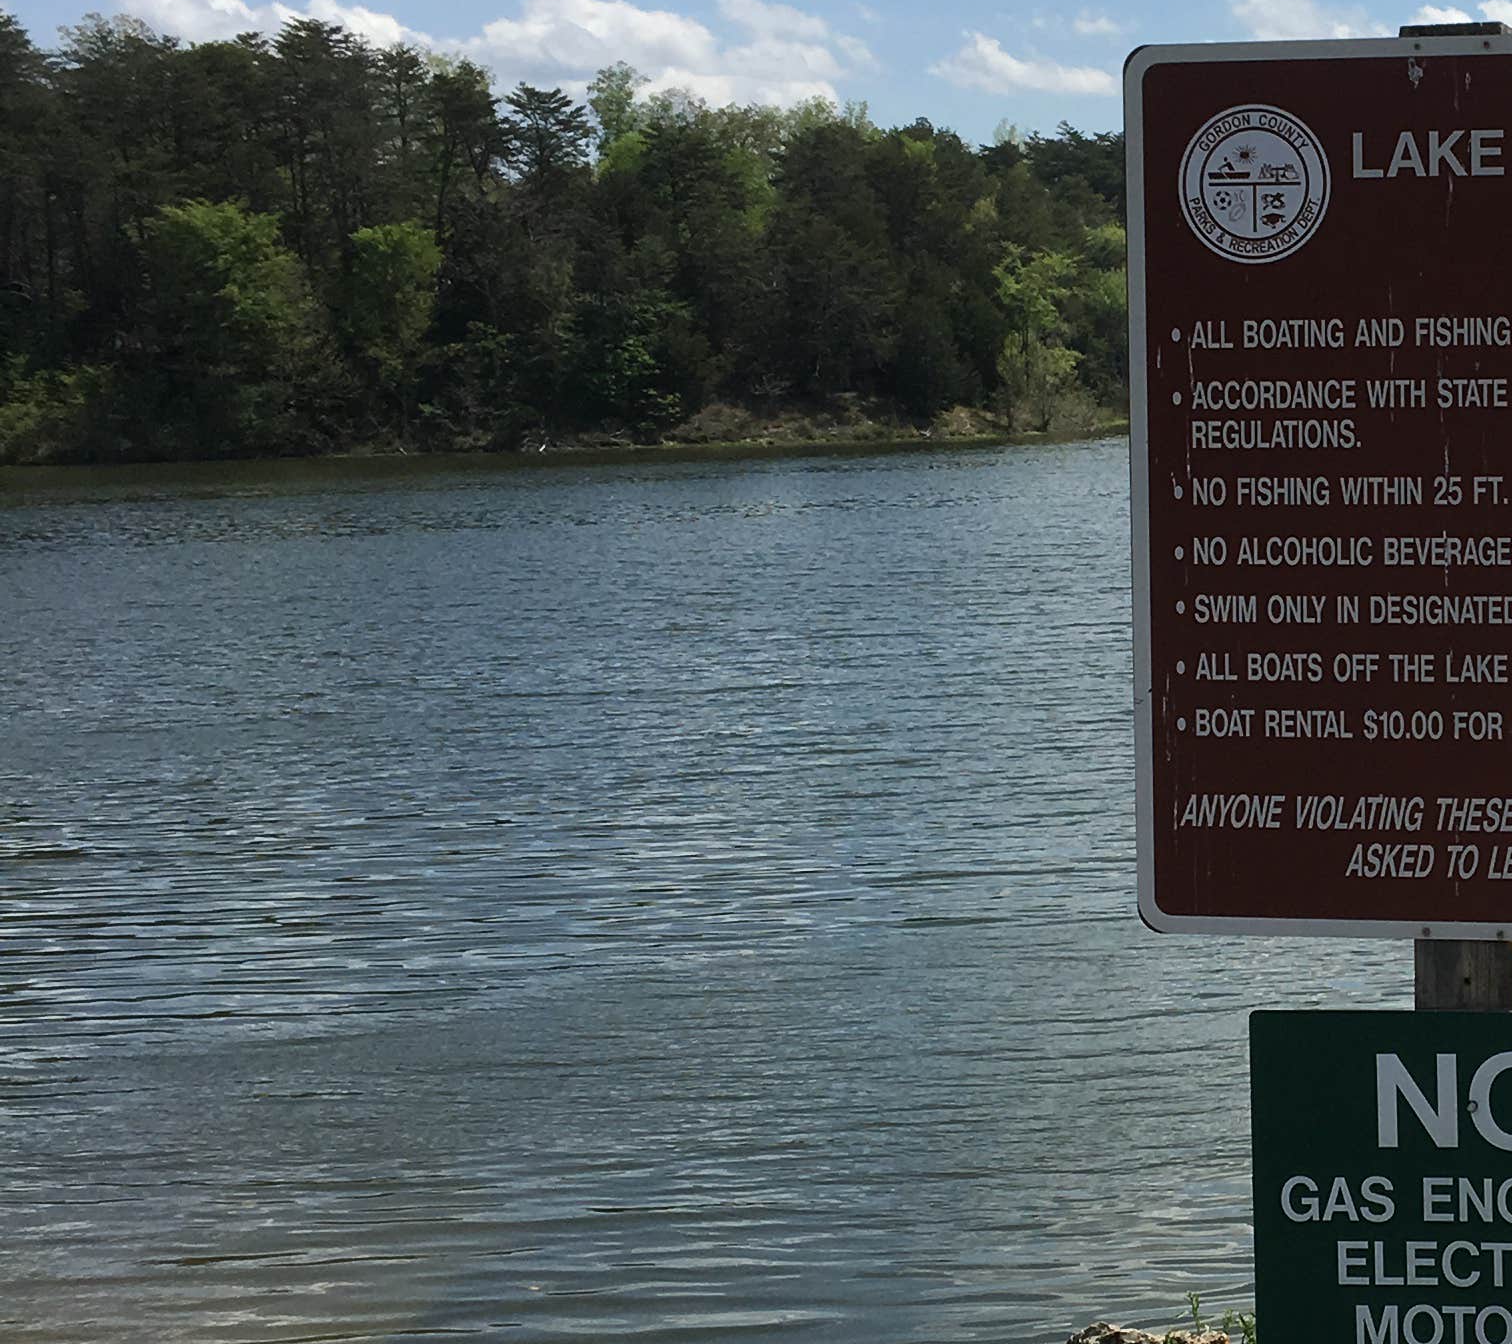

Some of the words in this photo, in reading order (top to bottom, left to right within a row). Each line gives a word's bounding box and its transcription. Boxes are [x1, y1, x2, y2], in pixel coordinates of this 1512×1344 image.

[1199, 114, 1250, 152] GORDON
[1259, 114, 1309, 149] COUNTY
[1353, 129, 1505, 179] LAKE
[1189, 197, 1216, 234] PARKS
[1216, 233, 1227, 243] &
[1229, 229, 1299, 253] RECREATION
[1192, 320, 1234, 350] ALL
[1243, 319, 1344, 349] BOATING
[1355, 318, 1404, 347] AND
[1415, 317, 1511, 347] FISHING
[1192, 380, 1356, 410] ACCORDANCE
[1367, 379, 1427, 409] WITH
[1437, 378, 1507, 408] STATE
[1192, 419, 1361, 449] REGULATIONS.
[1192, 478, 1226, 507] NO
[1237, 477, 1330, 506] FISHING
[1340, 477, 1423, 506] WITHIN
[1433, 476, 1462, 506] 25
[1473, 476, 1508, 505] FT.
[1193, 537, 1226, 566] NO
[1237, 537, 1372, 566] ALCOHOLIC
[1194, 595, 1257, 624] SWIM
[1267, 595, 1326, 624] ONLY
[1337, 596, 1359, 624] IN
[1196, 654, 1237, 682] ALL
[1247, 654, 1323, 683] BOATS
[1334, 654, 1379, 683] OFF
[1389, 655, 1434, 683] THE
[1446, 655, 1507, 683] LAKE
[1196, 709, 1254, 738] BOAT
[1265, 710, 1353, 739] RENTAL
[1363, 709, 1443, 741] $10.00
[1454, 712, 1502, 740] FOR
[1181, 794, 1285, 829] ANYONE
[1296, 796, 1425, 832] VIOLATING
[1346, 843, 1434, 878] ASKED
[1446, 844, 1479, 880] TO
[1281, 1175, 1395, 1222] GAS
